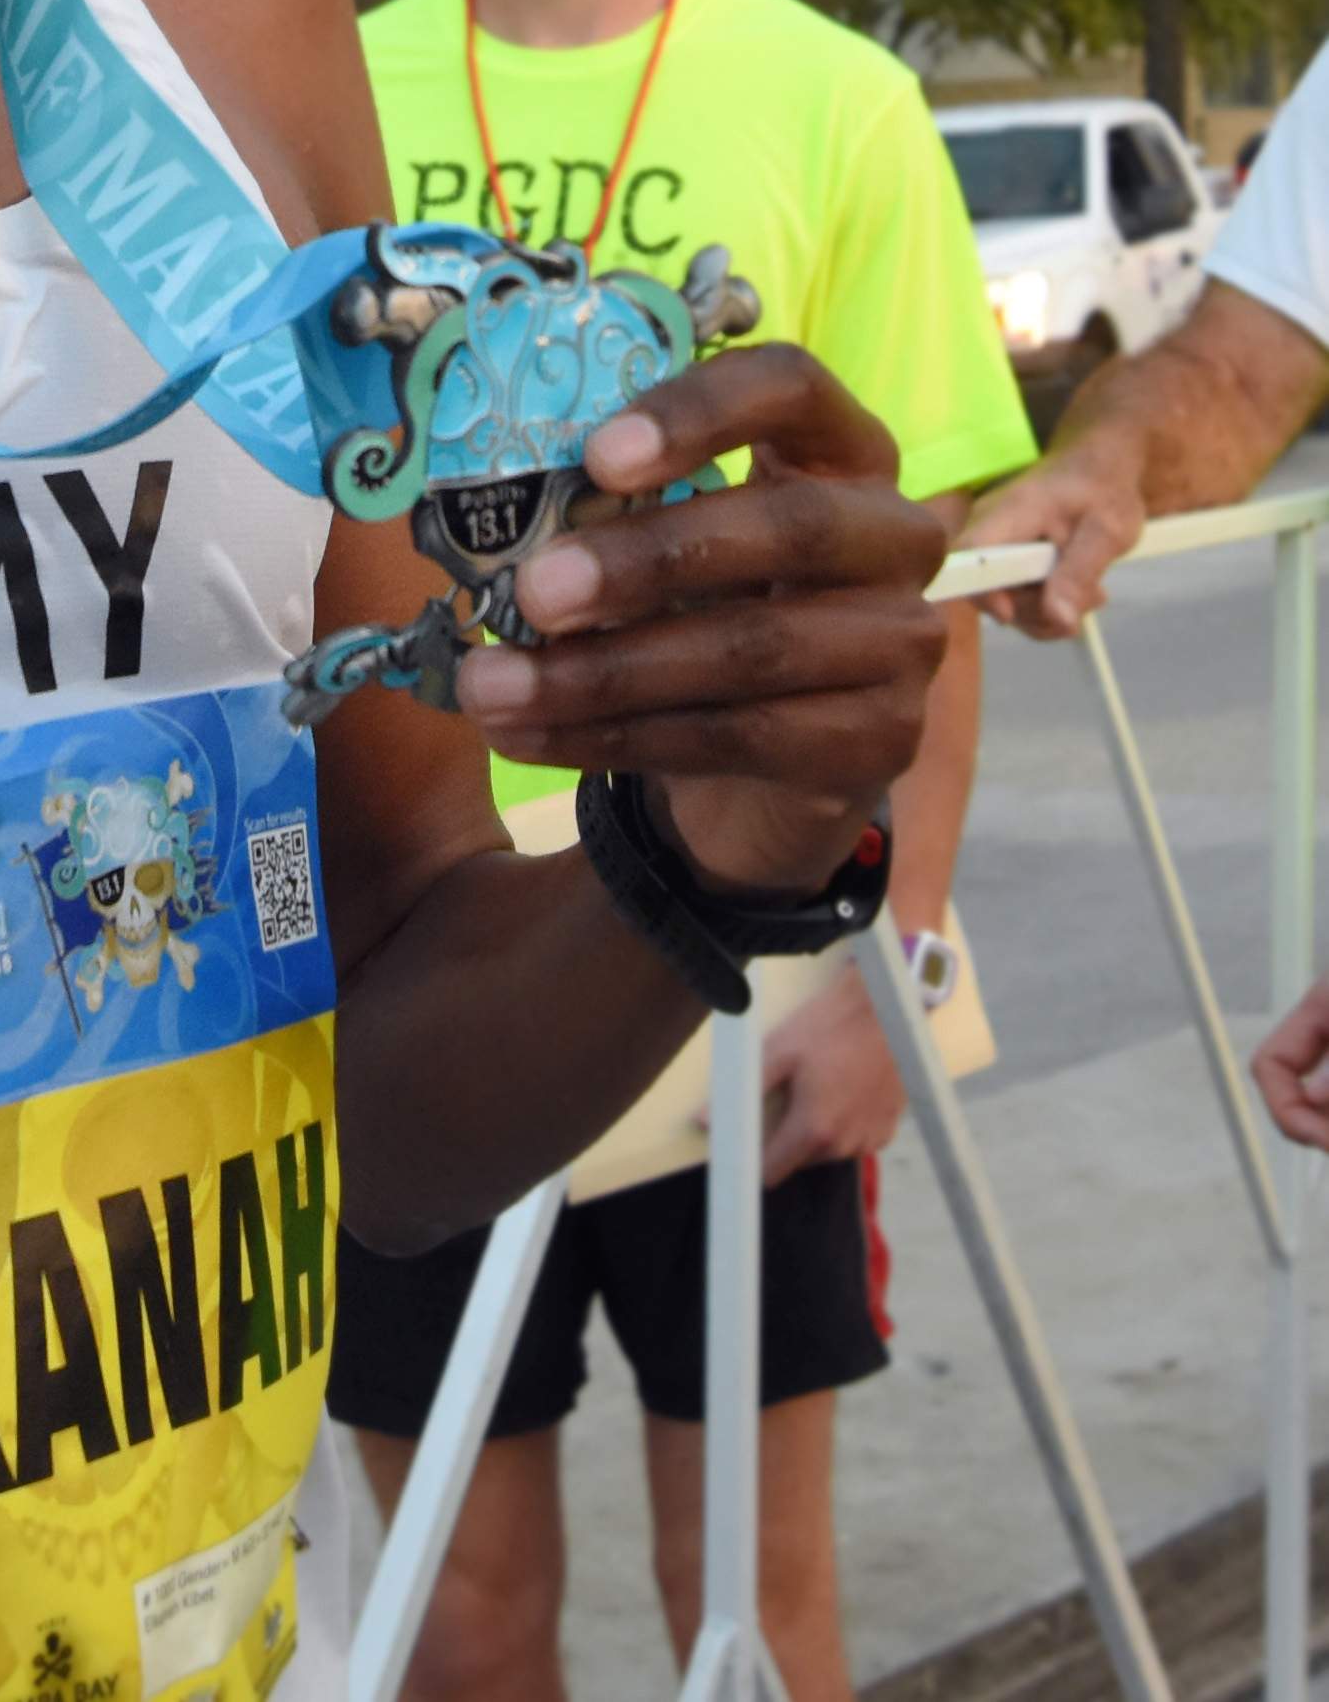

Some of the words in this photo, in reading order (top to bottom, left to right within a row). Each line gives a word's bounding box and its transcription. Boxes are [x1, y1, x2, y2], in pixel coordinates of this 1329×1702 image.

[411, 157, 684, 255] PGDC
[465, 503, 519, 548] 13.1
[74, 1672, 120, 1702] BAY
